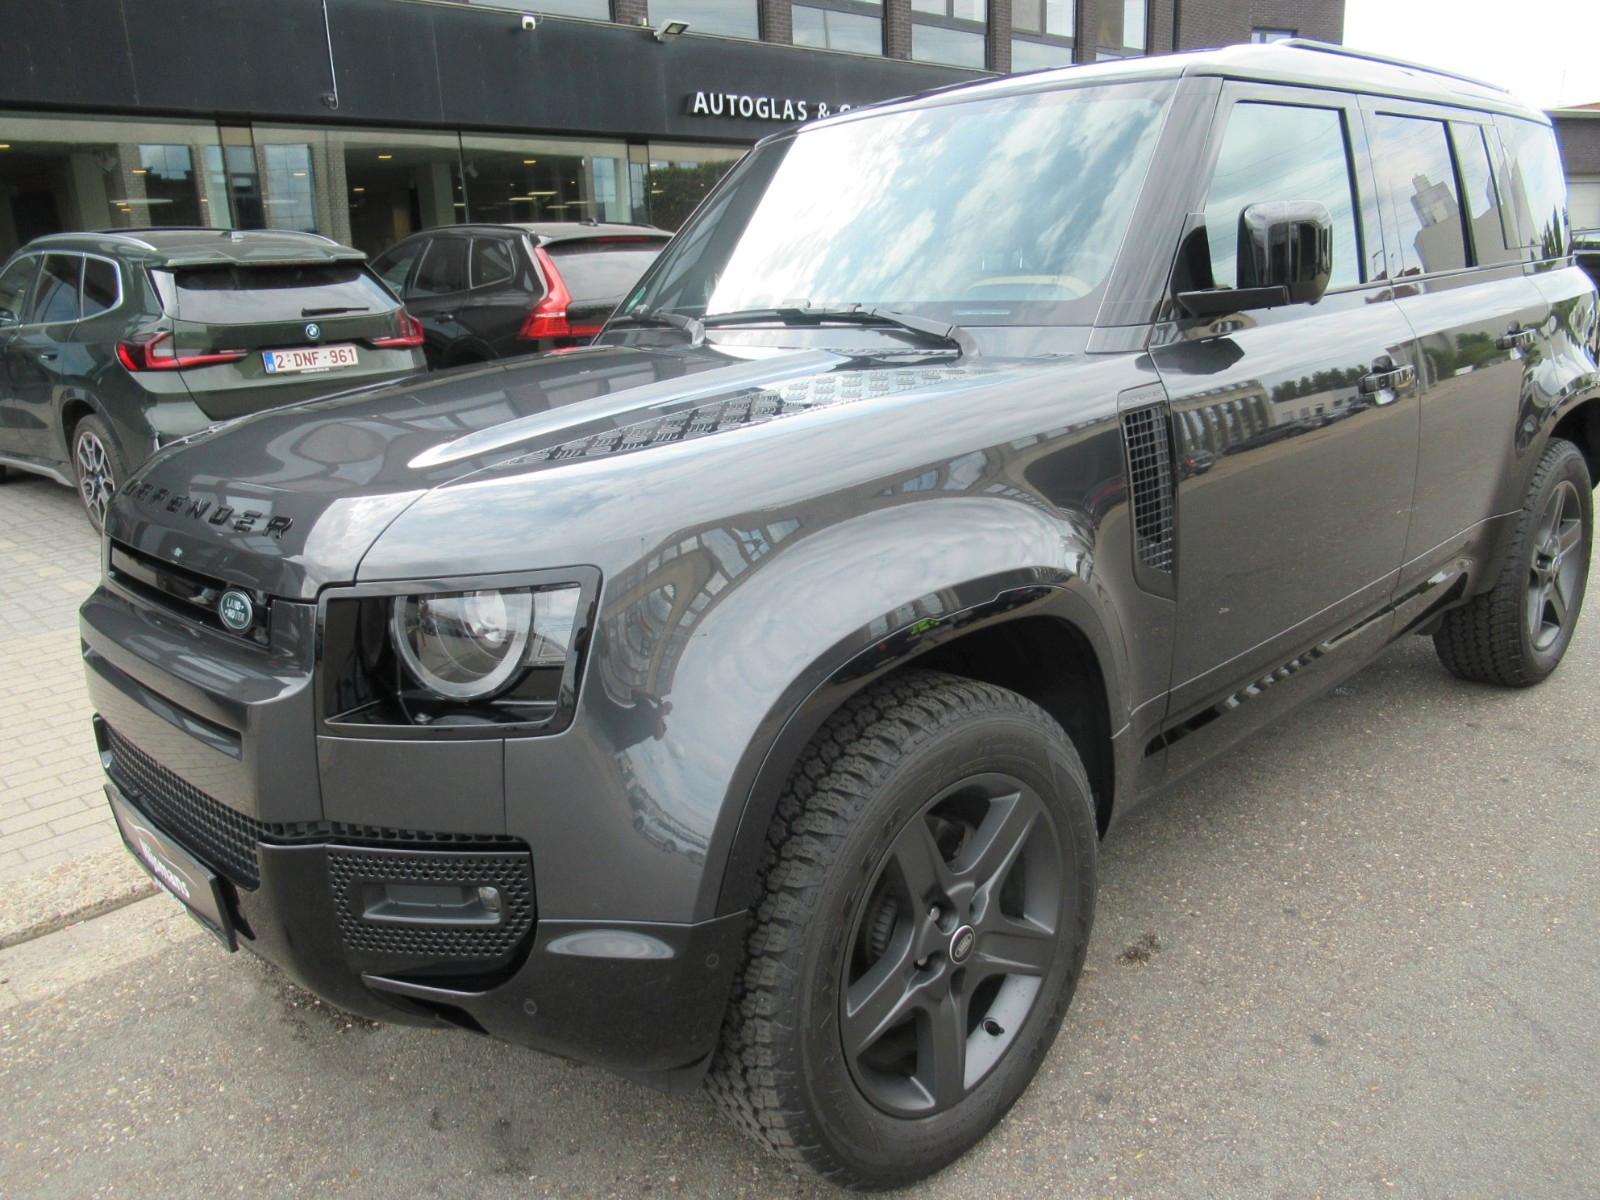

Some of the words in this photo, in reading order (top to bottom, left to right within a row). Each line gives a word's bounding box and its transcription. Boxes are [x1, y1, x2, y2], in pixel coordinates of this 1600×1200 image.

[693, 91, 807, 121] AUTOGLAS
[817, 102, 830, 119] &
[122, 480, 293, 540] DEFENDER
